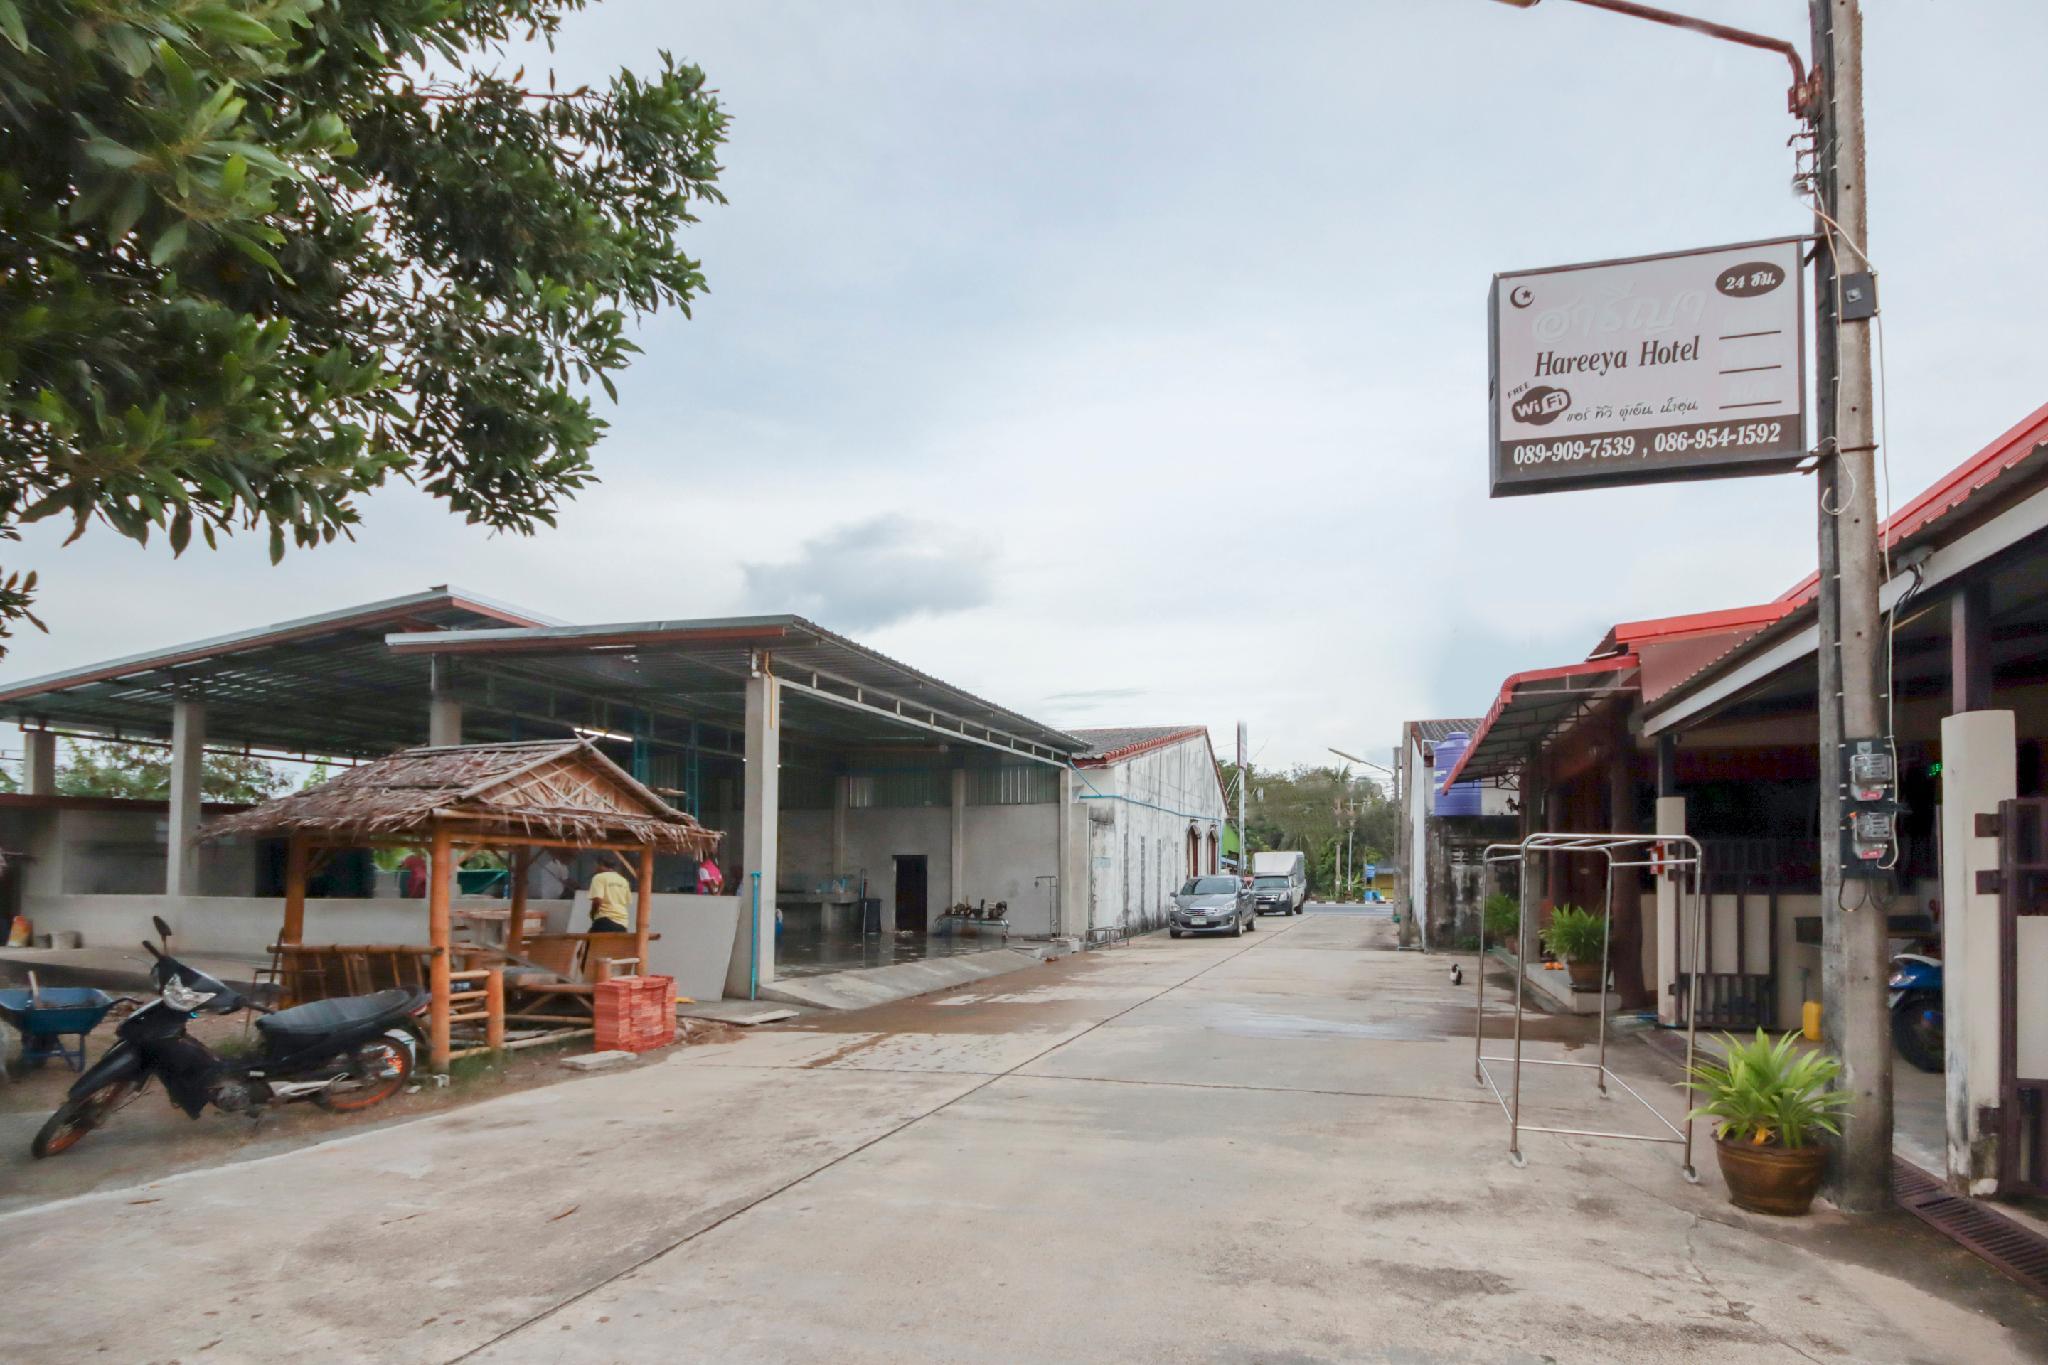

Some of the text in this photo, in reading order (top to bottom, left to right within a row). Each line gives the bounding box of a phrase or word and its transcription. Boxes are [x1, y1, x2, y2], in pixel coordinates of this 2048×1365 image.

[1725, 275, 1746, 290] 24
[1534, 335, 1700, 377] Hareeya Hotel
[1507, 381, 1530, 399] FREE
[1513, 435, 1637, 465] 089-909-7539
[1653, 421, 1782, 453] 086-954-1592
